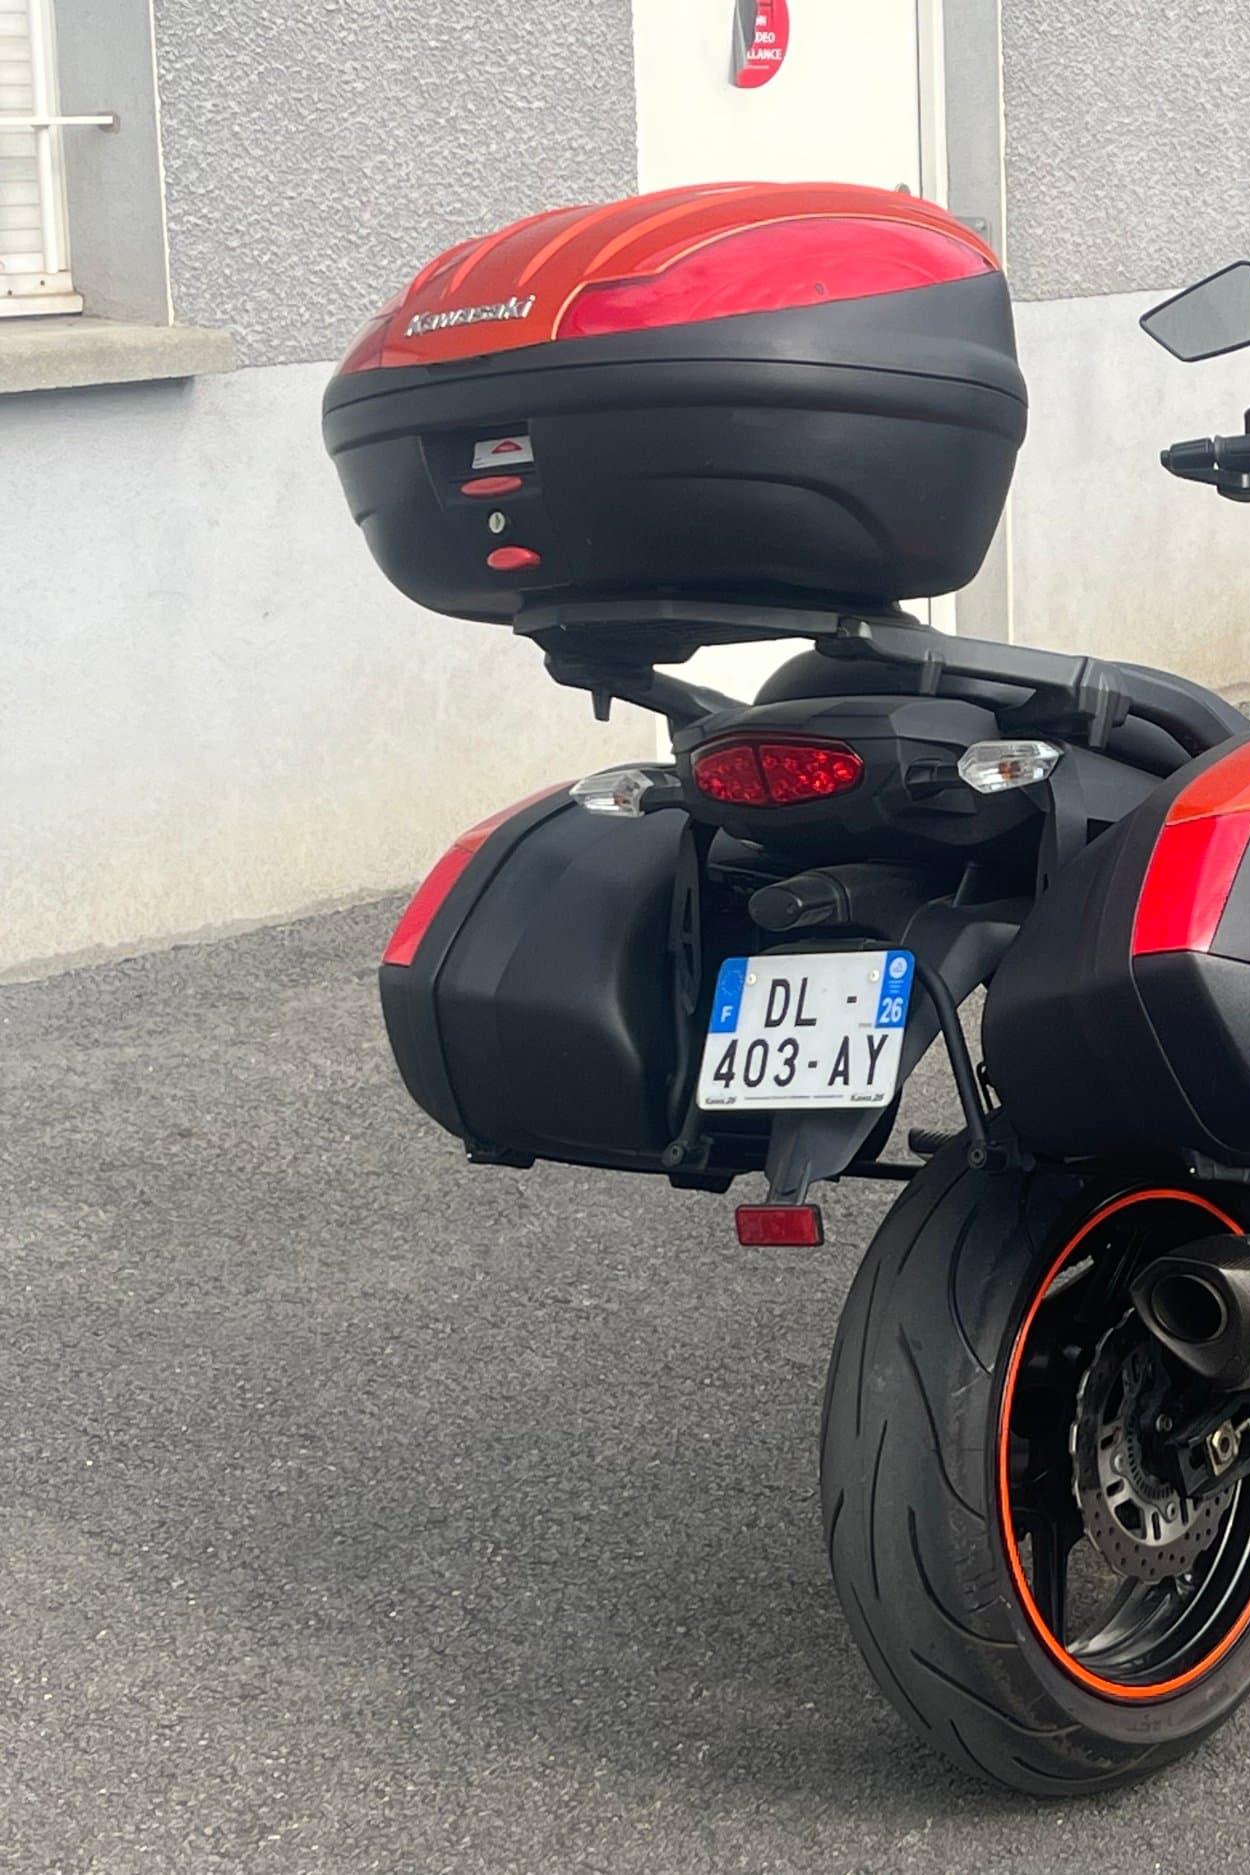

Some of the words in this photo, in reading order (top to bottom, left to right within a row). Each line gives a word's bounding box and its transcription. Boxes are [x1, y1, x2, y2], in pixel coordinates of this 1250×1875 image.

[407, 295, 536, 336] Kawasaki
[720, 1005, 734, 1023] F
[879, 997, 904, 1023] 26
[713, 1035, 889, 1088] 403-AY
